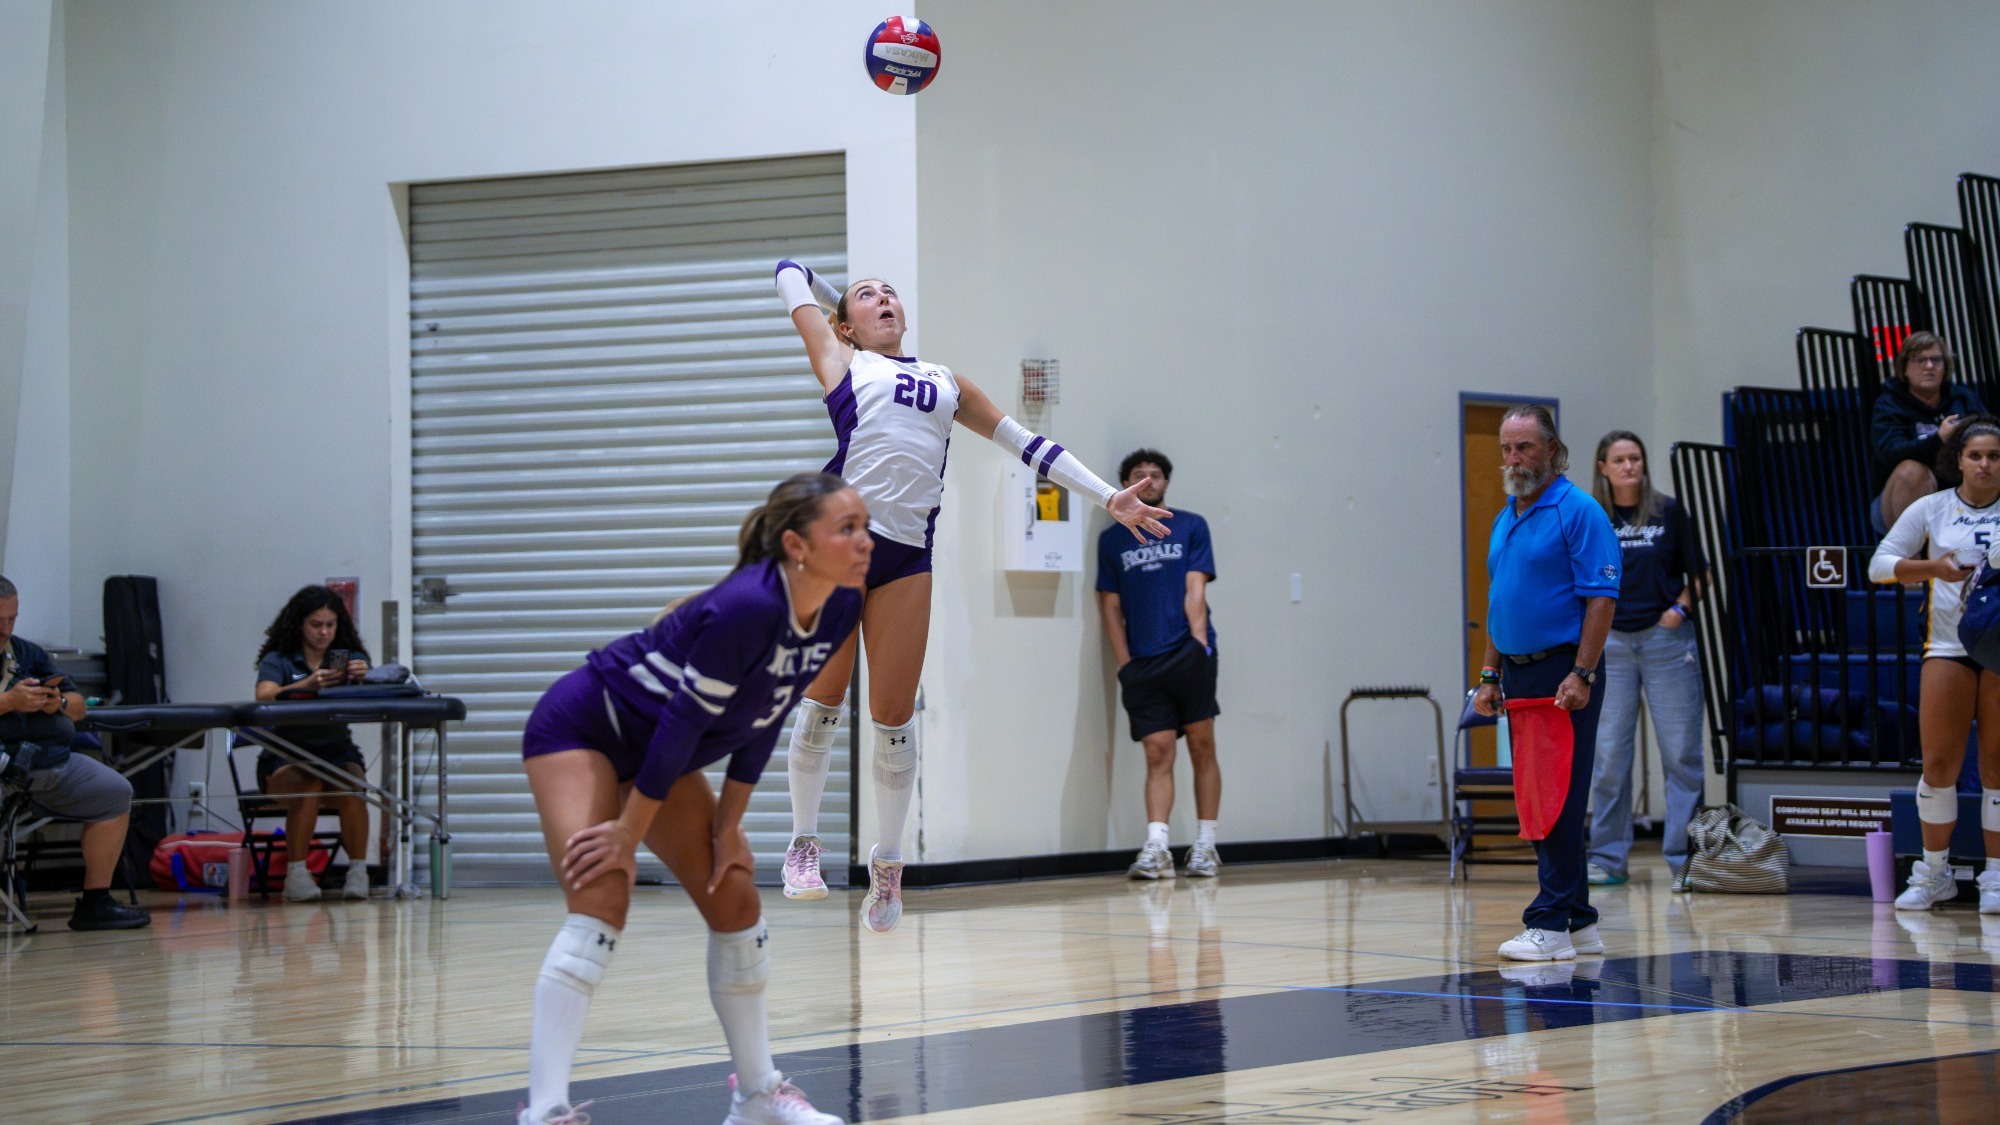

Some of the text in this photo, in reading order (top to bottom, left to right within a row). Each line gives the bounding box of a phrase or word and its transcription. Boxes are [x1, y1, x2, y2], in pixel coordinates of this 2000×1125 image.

[885, 45, 930, 62] MIKASA
[893, 373, 937, 413] 20
[1621, 539, 1654, 547] EYBALL
[1974, 531, 1991, 550] 5
[1120, 543, 1184, 572] ROYALS
[1775, 806, 1892, 817] COMPANION SEAT WILL BE MADE
[1785, 818, 1825, 826] AVAILABLE
[1825, 819, 1848, 827] UPON
